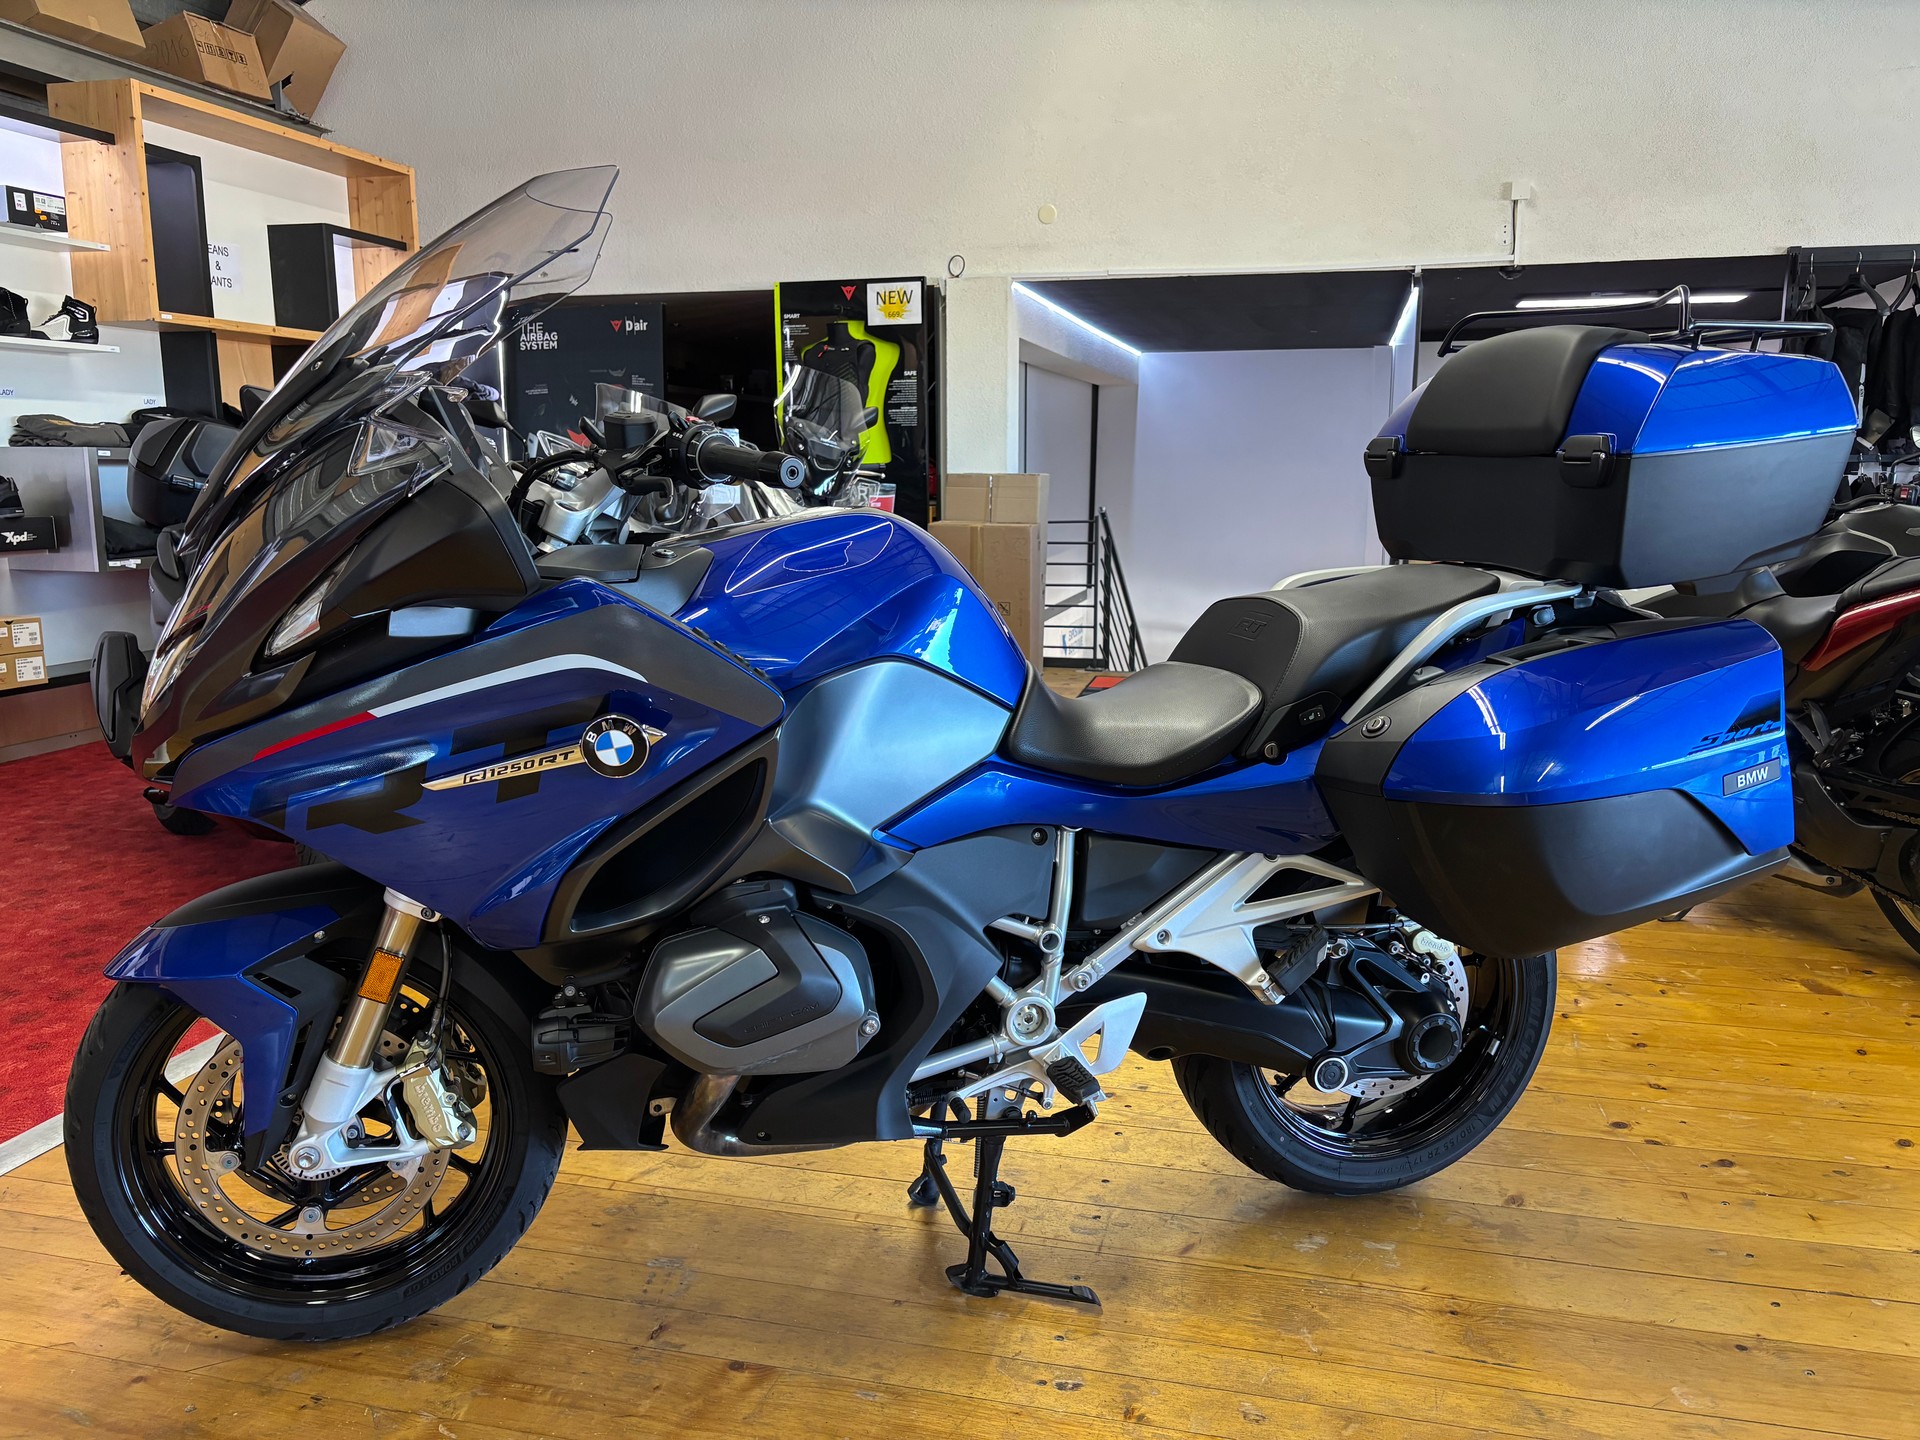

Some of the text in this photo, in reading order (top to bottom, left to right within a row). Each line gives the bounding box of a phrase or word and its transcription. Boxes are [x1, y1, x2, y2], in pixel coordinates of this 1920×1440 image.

[207, 243, 229, 257] EANS
[215, 260, 221, 271] &
[211, 275, 232, 289] ANTS
[876, 289, 914, 305] NEW
[520, 322, 543, 334] THE
[520, 332, 558, 341] AIRBAG
[520, 341, 558, 351] SYSTEM
[143, 398, 157, 406] LADY
[585, 719, 637, 744] BMW
[1737, 766, 1769, 789] BMW
[414, 1081, 443, 1134] brembo
